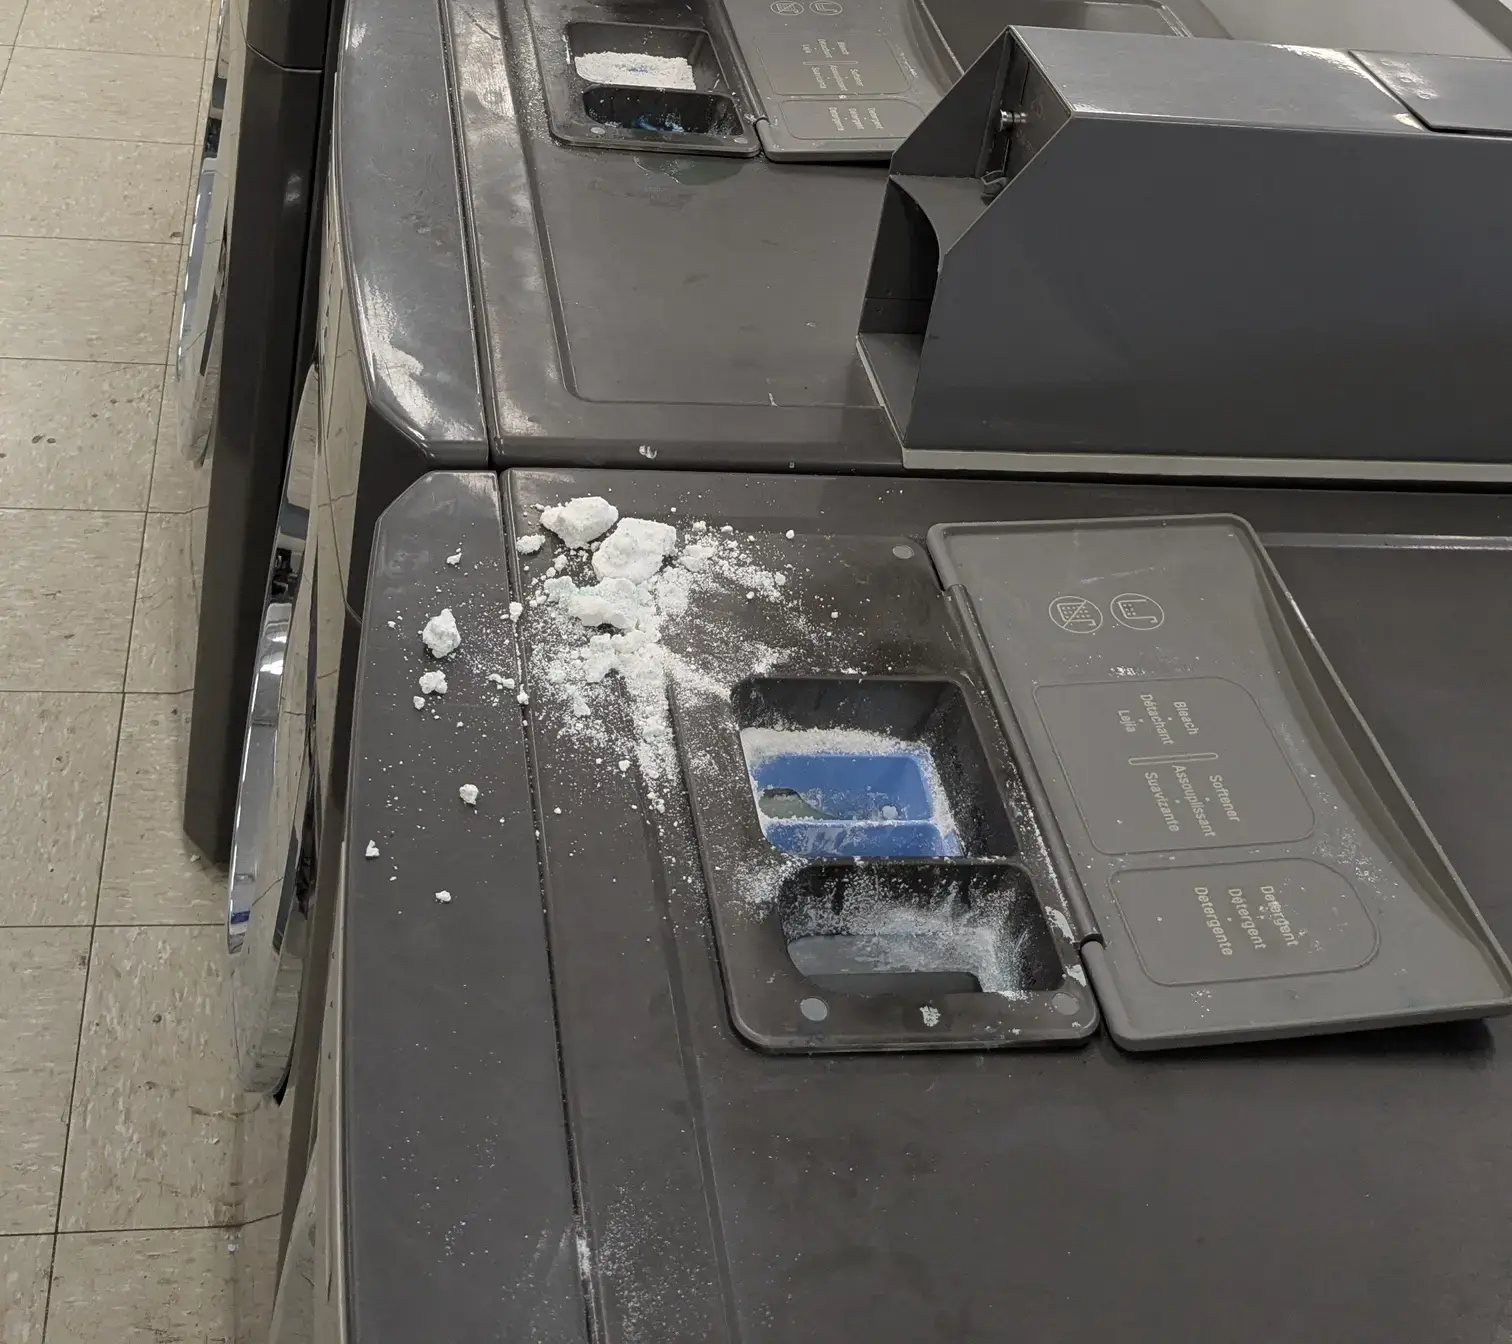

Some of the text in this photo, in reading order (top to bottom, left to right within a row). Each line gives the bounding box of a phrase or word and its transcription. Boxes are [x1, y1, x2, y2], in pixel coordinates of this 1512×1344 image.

[1117, 709, 1137, 733] Lejia
[1173, 700, 1200, 735] Bleach
[1144, 771, 1180, 833] Suavizante
[1172, 764, 1217, 837] Assouplissant
[1208, 774, 1240, 823] Softener
[1194, 886, 1233, 956] Detergente
[1260, 885, 1299, 947] Detergent
